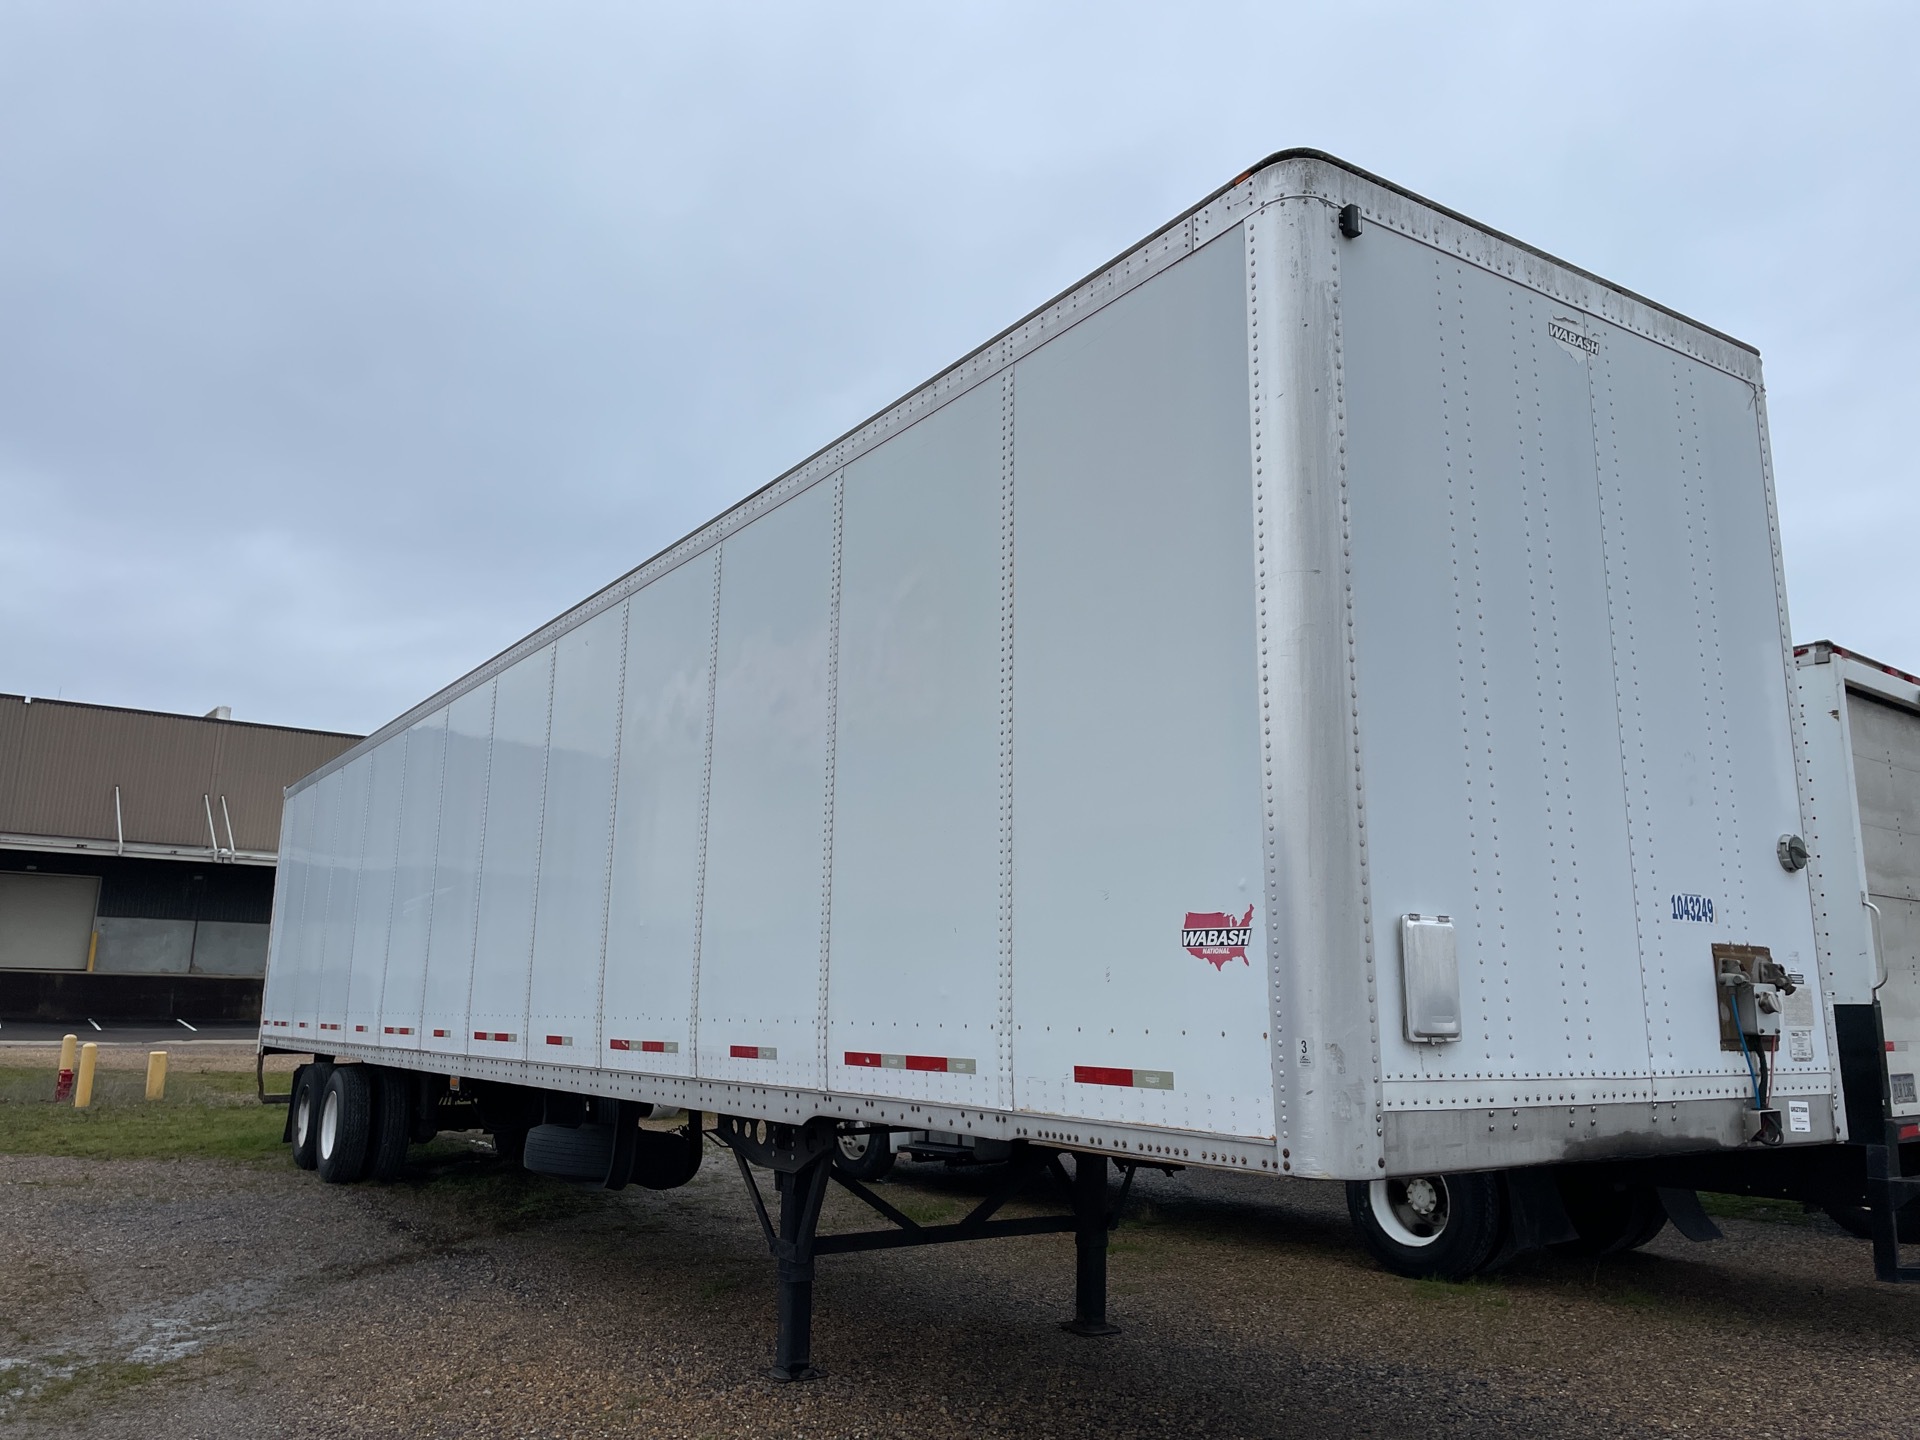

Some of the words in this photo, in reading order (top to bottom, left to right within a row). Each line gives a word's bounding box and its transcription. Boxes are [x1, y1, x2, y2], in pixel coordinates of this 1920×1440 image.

[1548, 323, 1600, 355] WABASH
[1671, 894, 1714, 923] 1043249
[1183, 930, 1251, 946] WABASH
[1202, 947, 1231, 955] NATIONAL
[1300, 1040, 1308, 1054] 3
